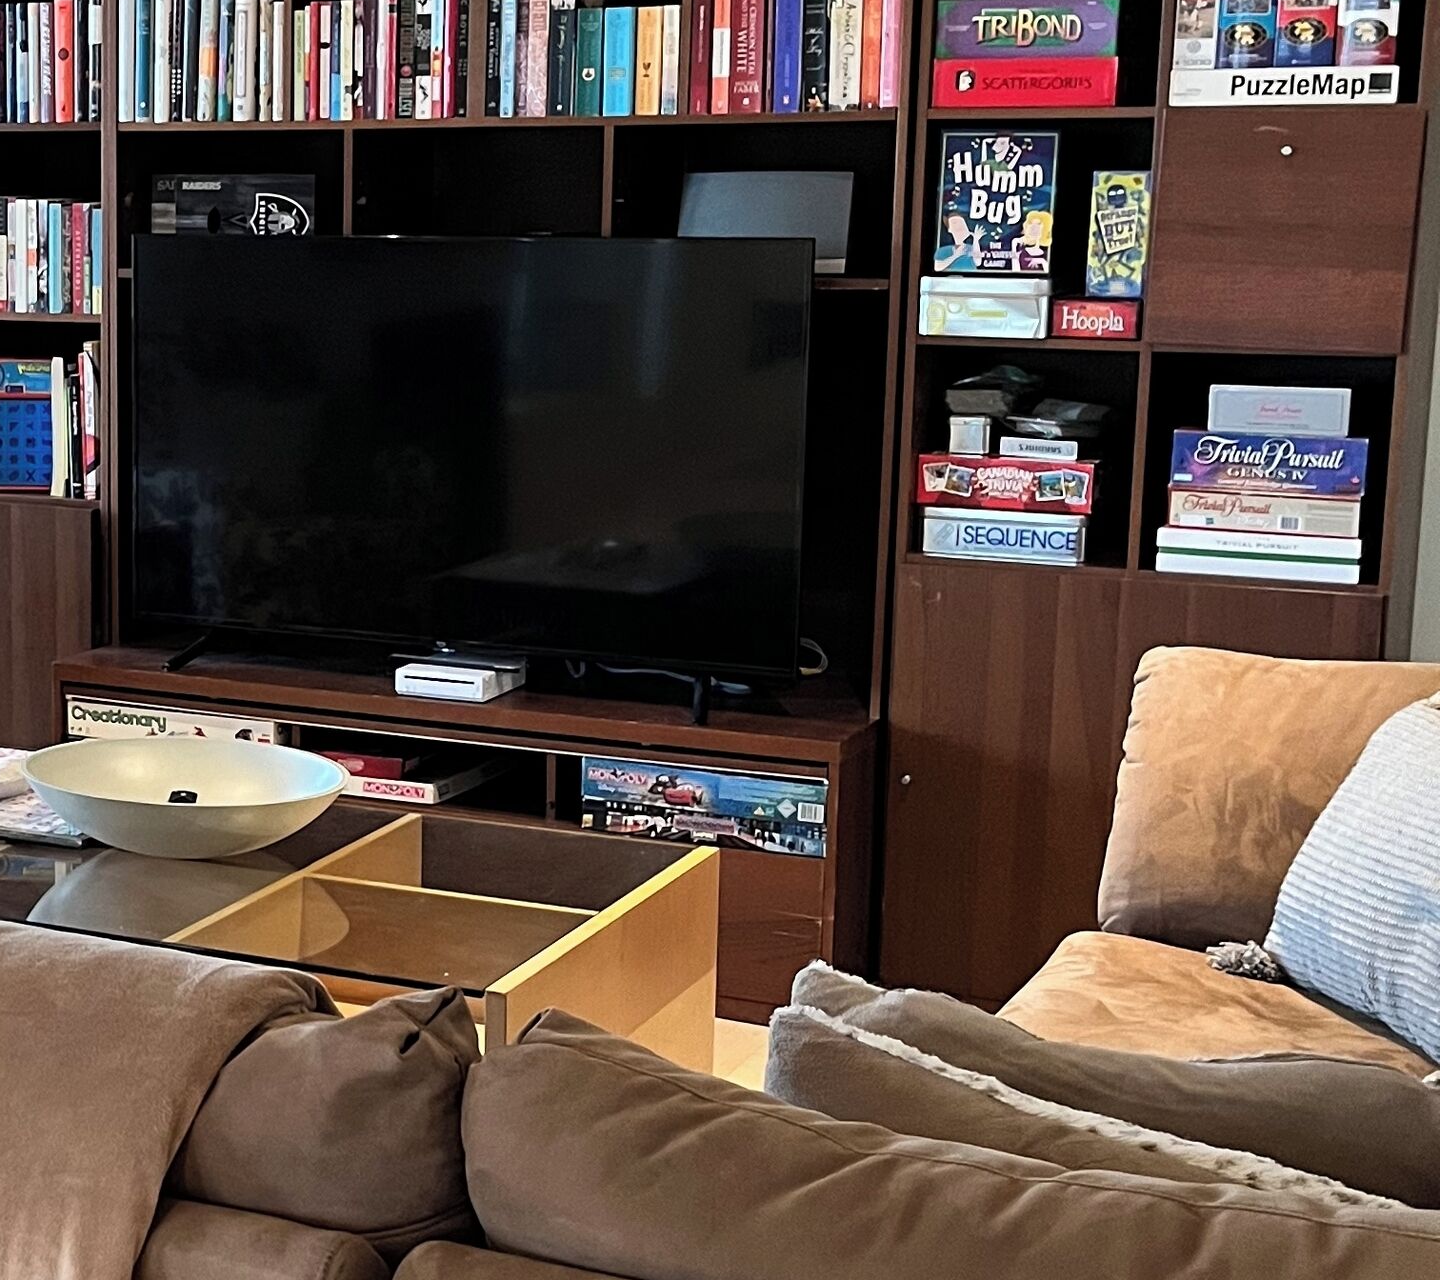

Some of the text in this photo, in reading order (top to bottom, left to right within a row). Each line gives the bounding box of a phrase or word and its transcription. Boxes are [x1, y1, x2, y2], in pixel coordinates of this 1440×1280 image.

[736, 30, 748, 73] WHITE
[982, 76, 1093, 90] SCATTERGORIES
[1230, 73, 1365, 99] PuzzleMap
[952, 151, 1044, 194] Humm
[182, 182, 222, 191] RAIDERS
[969, 189, 1022, 225] Bug
[1104, 220, 1135, 237] BUT
[1061, 306, 1124, 336] Hoopla
[1194, 436, 1345, 471] Trivial Pursuit
[976, 467, 1034, 483] CANADIAN
[1227, 467, 1308, 481] GENUS IV
[985, 478, 1024, 493] TRIVIA
[1183, 495, 1272, 517] Trivial Pursuit
[963, 525, 1079, 551] SEQUENCE
[71, 705, 167, 733] Creationary
[588, 767, 647, 785] MONOPOLY
[363, 782, 425, 799] MONOPOLY
